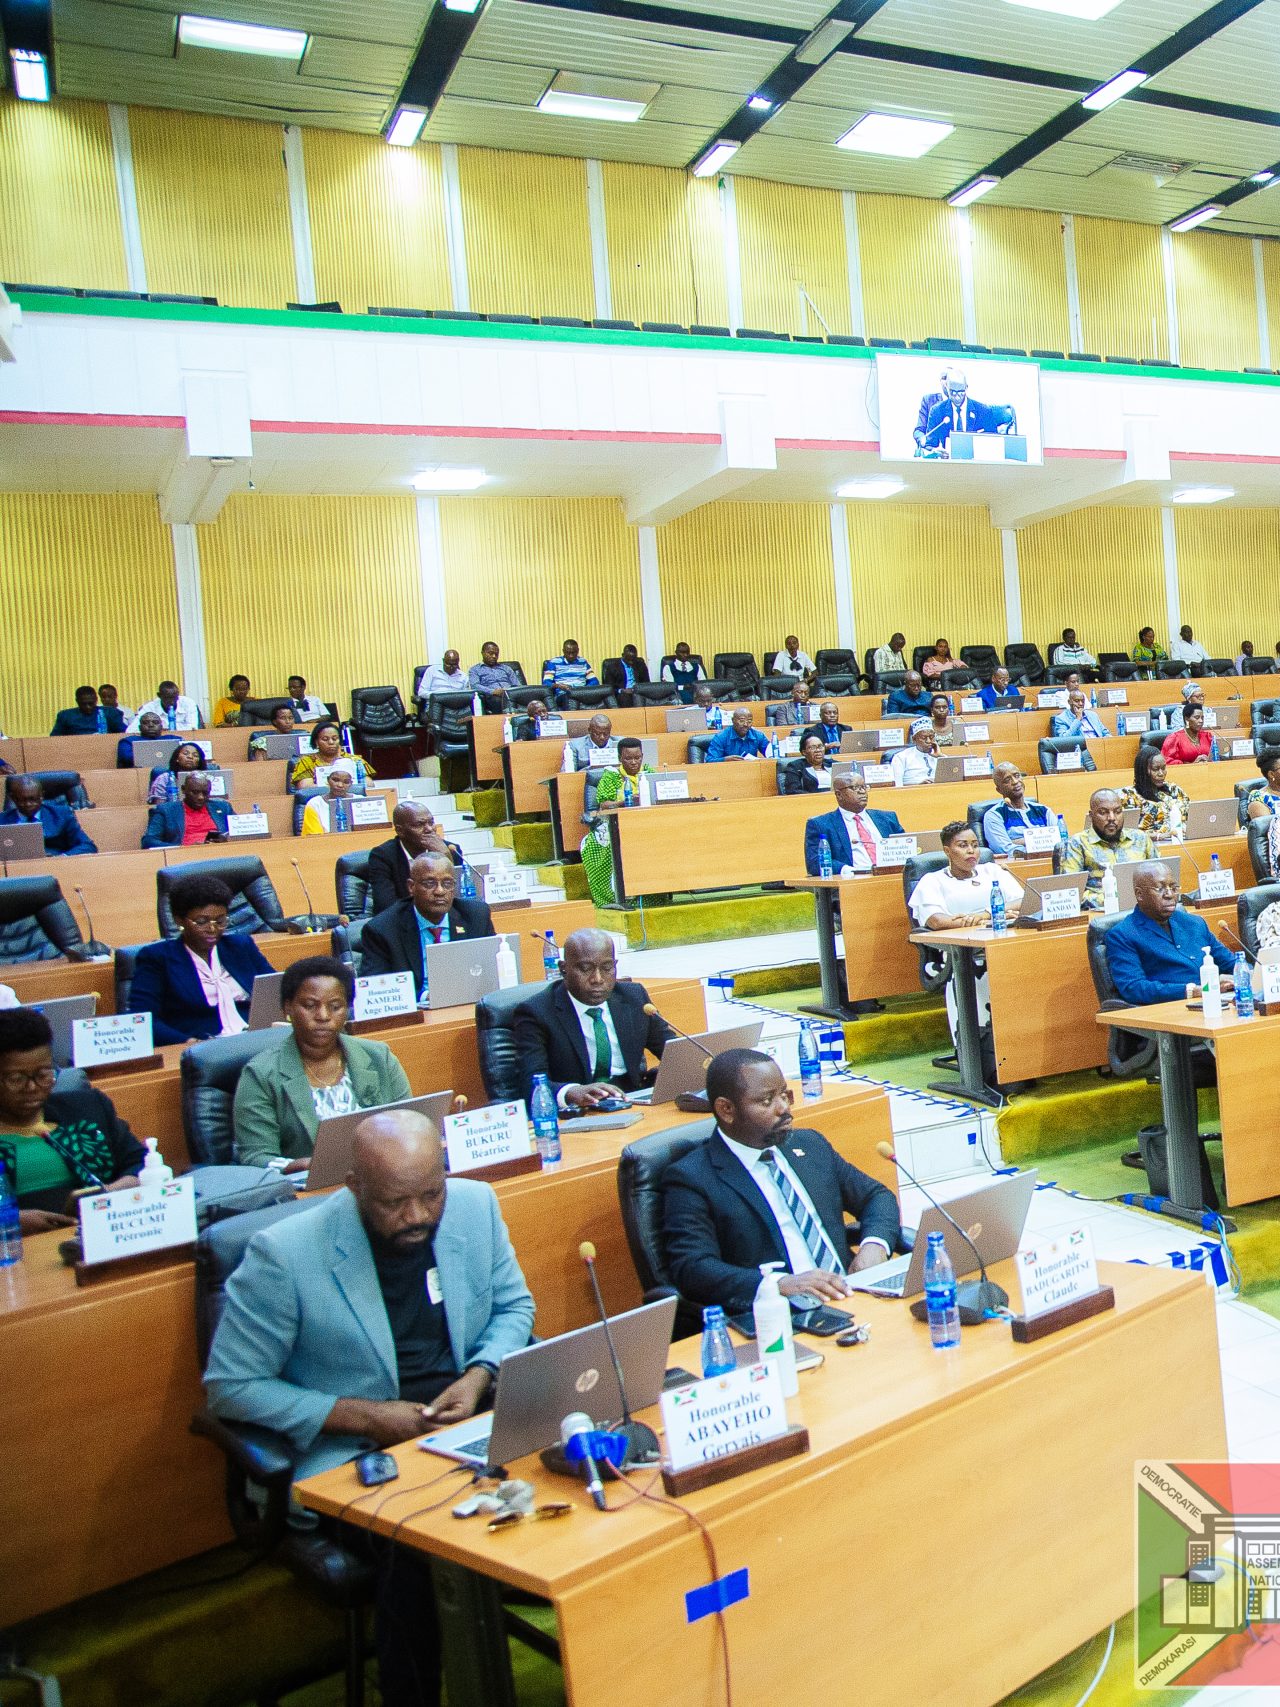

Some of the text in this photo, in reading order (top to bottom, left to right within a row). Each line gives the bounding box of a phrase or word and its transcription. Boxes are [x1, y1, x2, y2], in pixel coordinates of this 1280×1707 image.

[384, 1004, 408, 1012] Denise
[465, 1130, 513, 1149] BUKURU
[466, 1120, 510, 1136] Honorable
[107, 1201, 168, 1222] Honorable
[1034, 1250, 1082, 1279] Honorable
[1042, 1281, 1080, 1304] Claude
[688, 1391, 762, 1424] Honorable
[684, 1404, 772, 1446] ABAYEHO
[702, 1432, 763, 1463] Gervais
